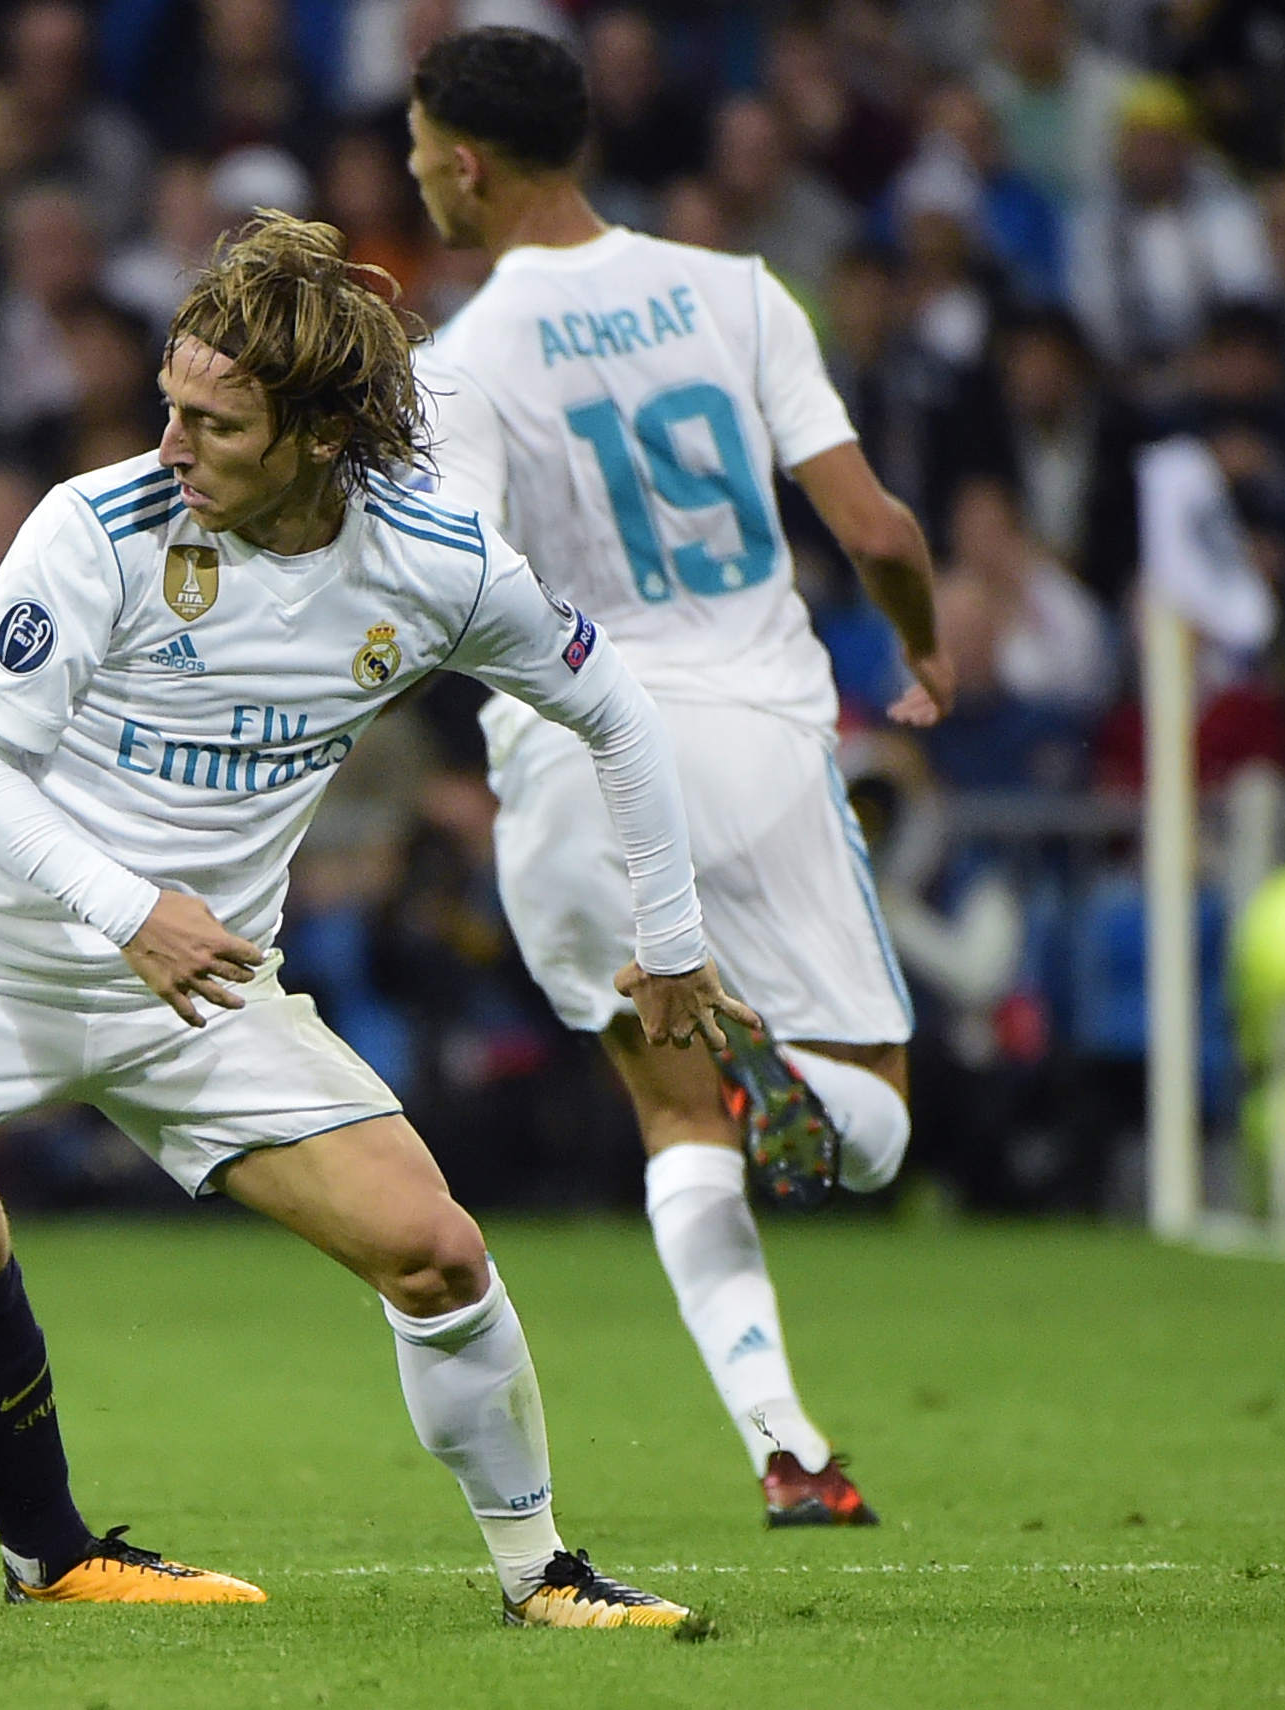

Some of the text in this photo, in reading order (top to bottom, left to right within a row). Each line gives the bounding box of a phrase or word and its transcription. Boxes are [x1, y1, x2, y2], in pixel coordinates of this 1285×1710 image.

[537, 285, 695, 368] ACHRAF
[564, 380, 776, 604] 19
[177, 592, 204, 604] FIFA
[148, 653, 206, 672] adidas
